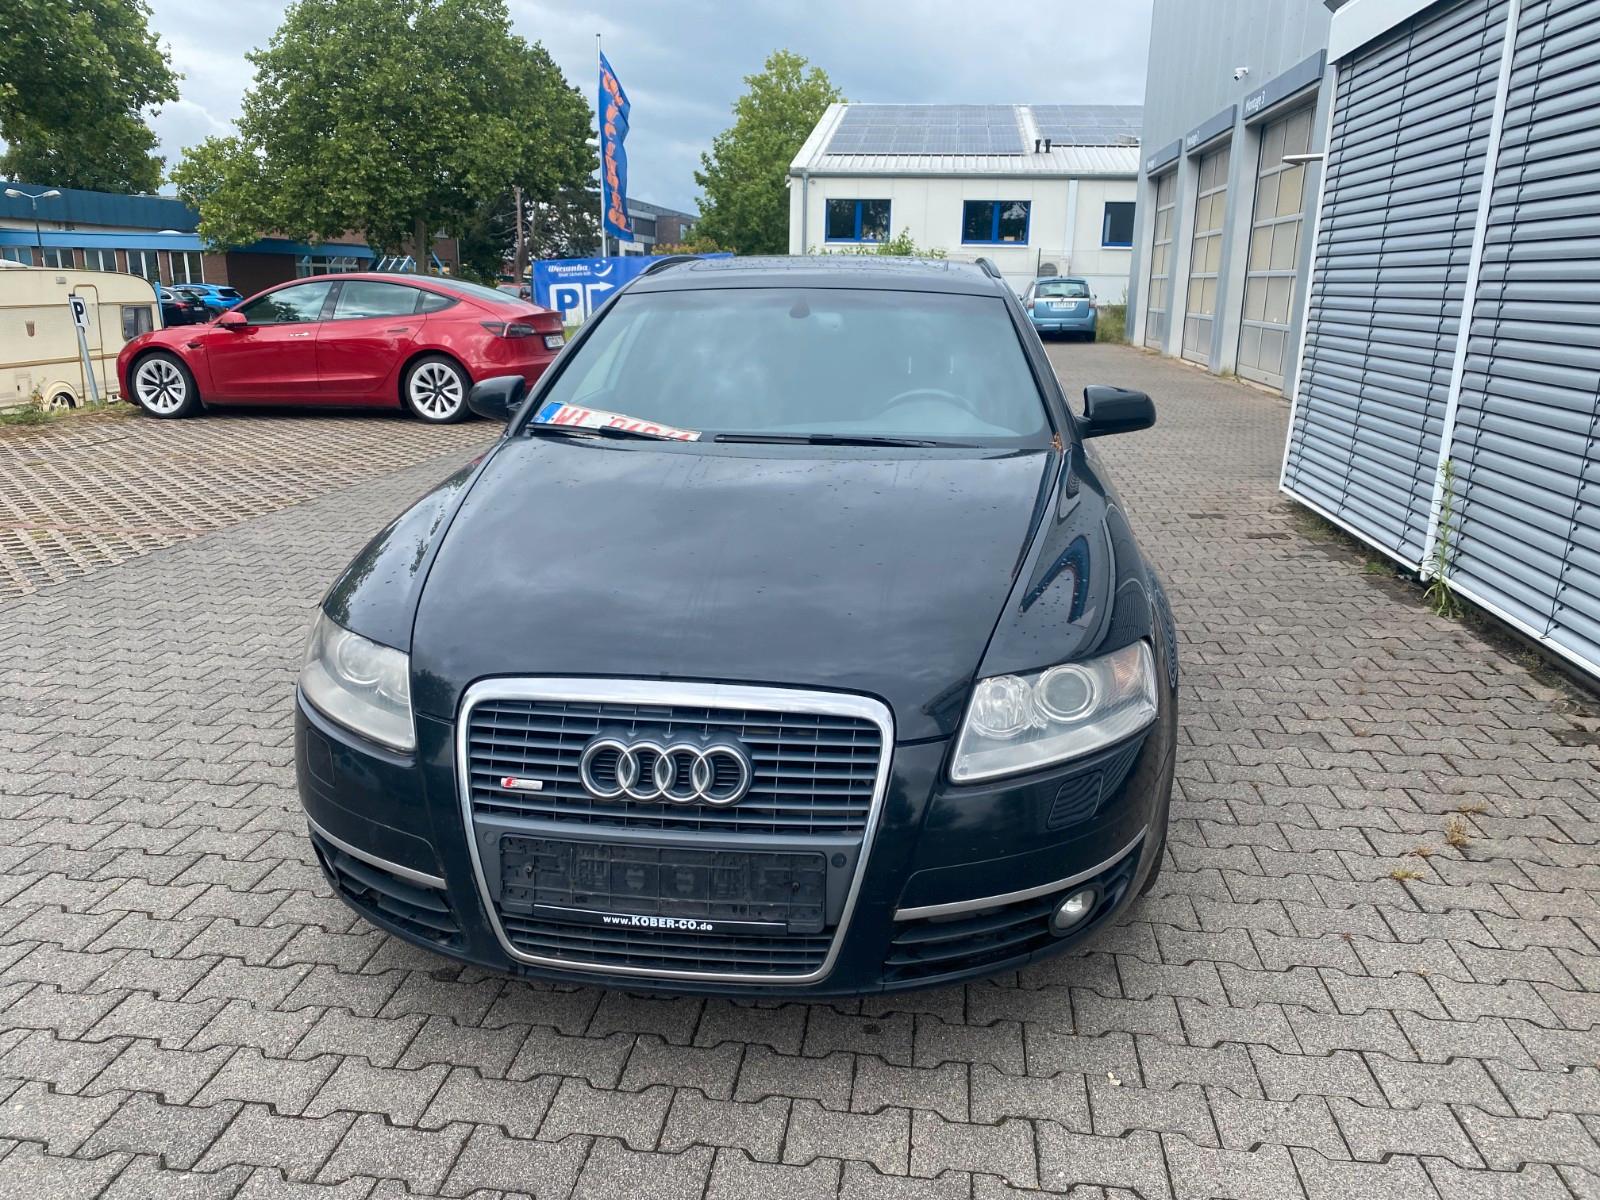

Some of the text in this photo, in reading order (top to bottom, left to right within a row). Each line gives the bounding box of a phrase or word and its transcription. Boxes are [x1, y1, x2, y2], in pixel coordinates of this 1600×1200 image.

[73, 302, 84, 323] P
[556, 288, 580, 321] P
[602, 916, 713, 931] www.KOBER-CO.de
